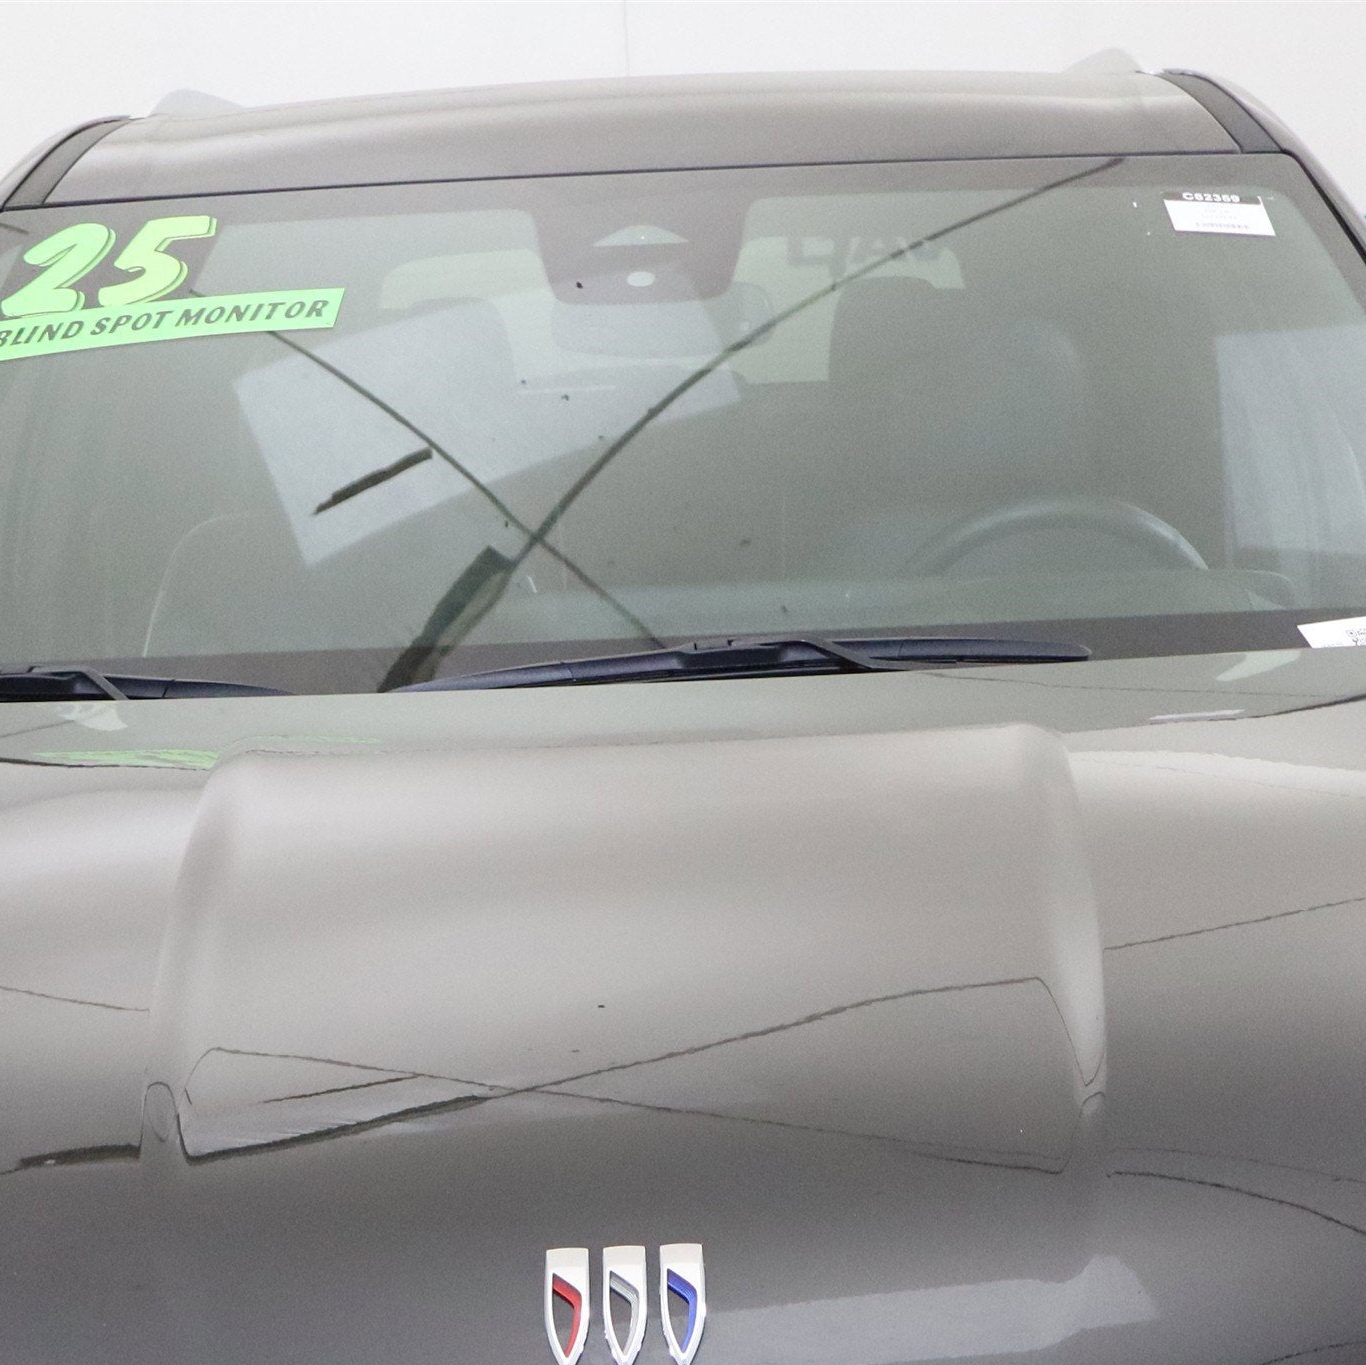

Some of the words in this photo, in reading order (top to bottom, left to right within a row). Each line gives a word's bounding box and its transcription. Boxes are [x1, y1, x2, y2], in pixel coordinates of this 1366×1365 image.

[1, 215, 217, 319] 25
[90, 310, 173, 336] SPOT
[174, 299, 329, 327] MONITOR
